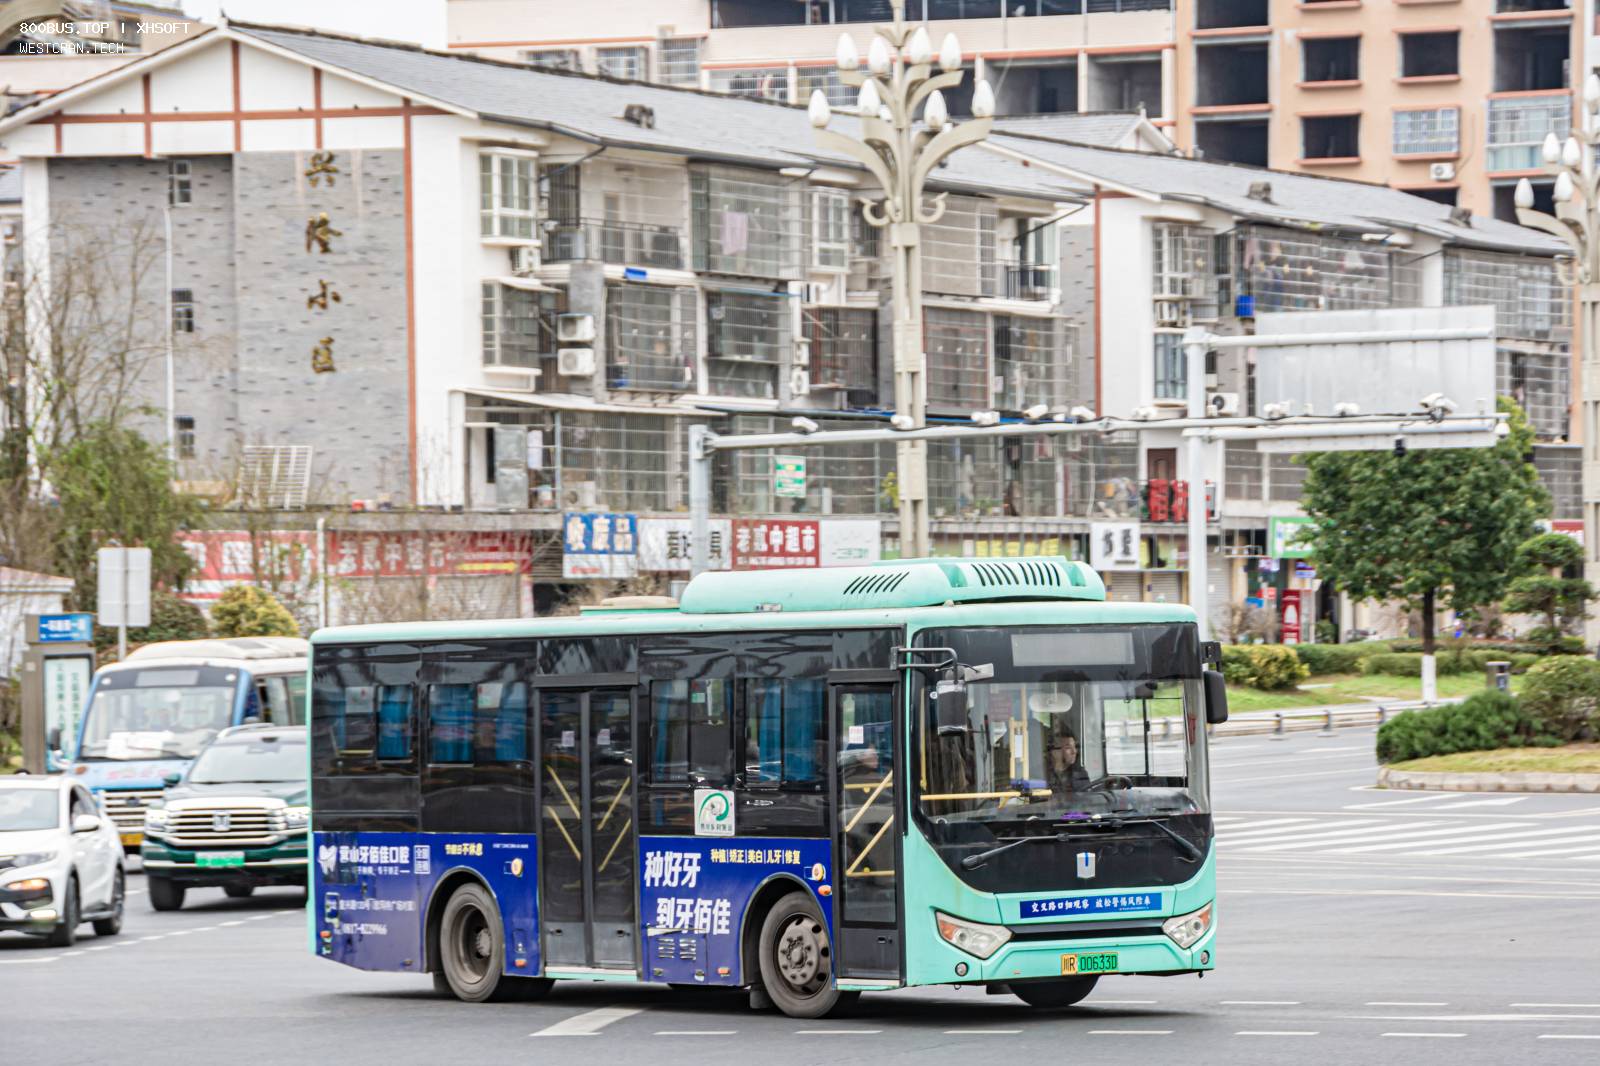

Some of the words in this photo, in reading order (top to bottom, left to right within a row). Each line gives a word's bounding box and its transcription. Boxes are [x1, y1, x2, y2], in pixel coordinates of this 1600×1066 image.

[339, 845, 410, 864] 营山牙佰佳口腔
[644, 850, 701, 888] 种好牙
[655, 897, 731, 935] 到牙佰佳
